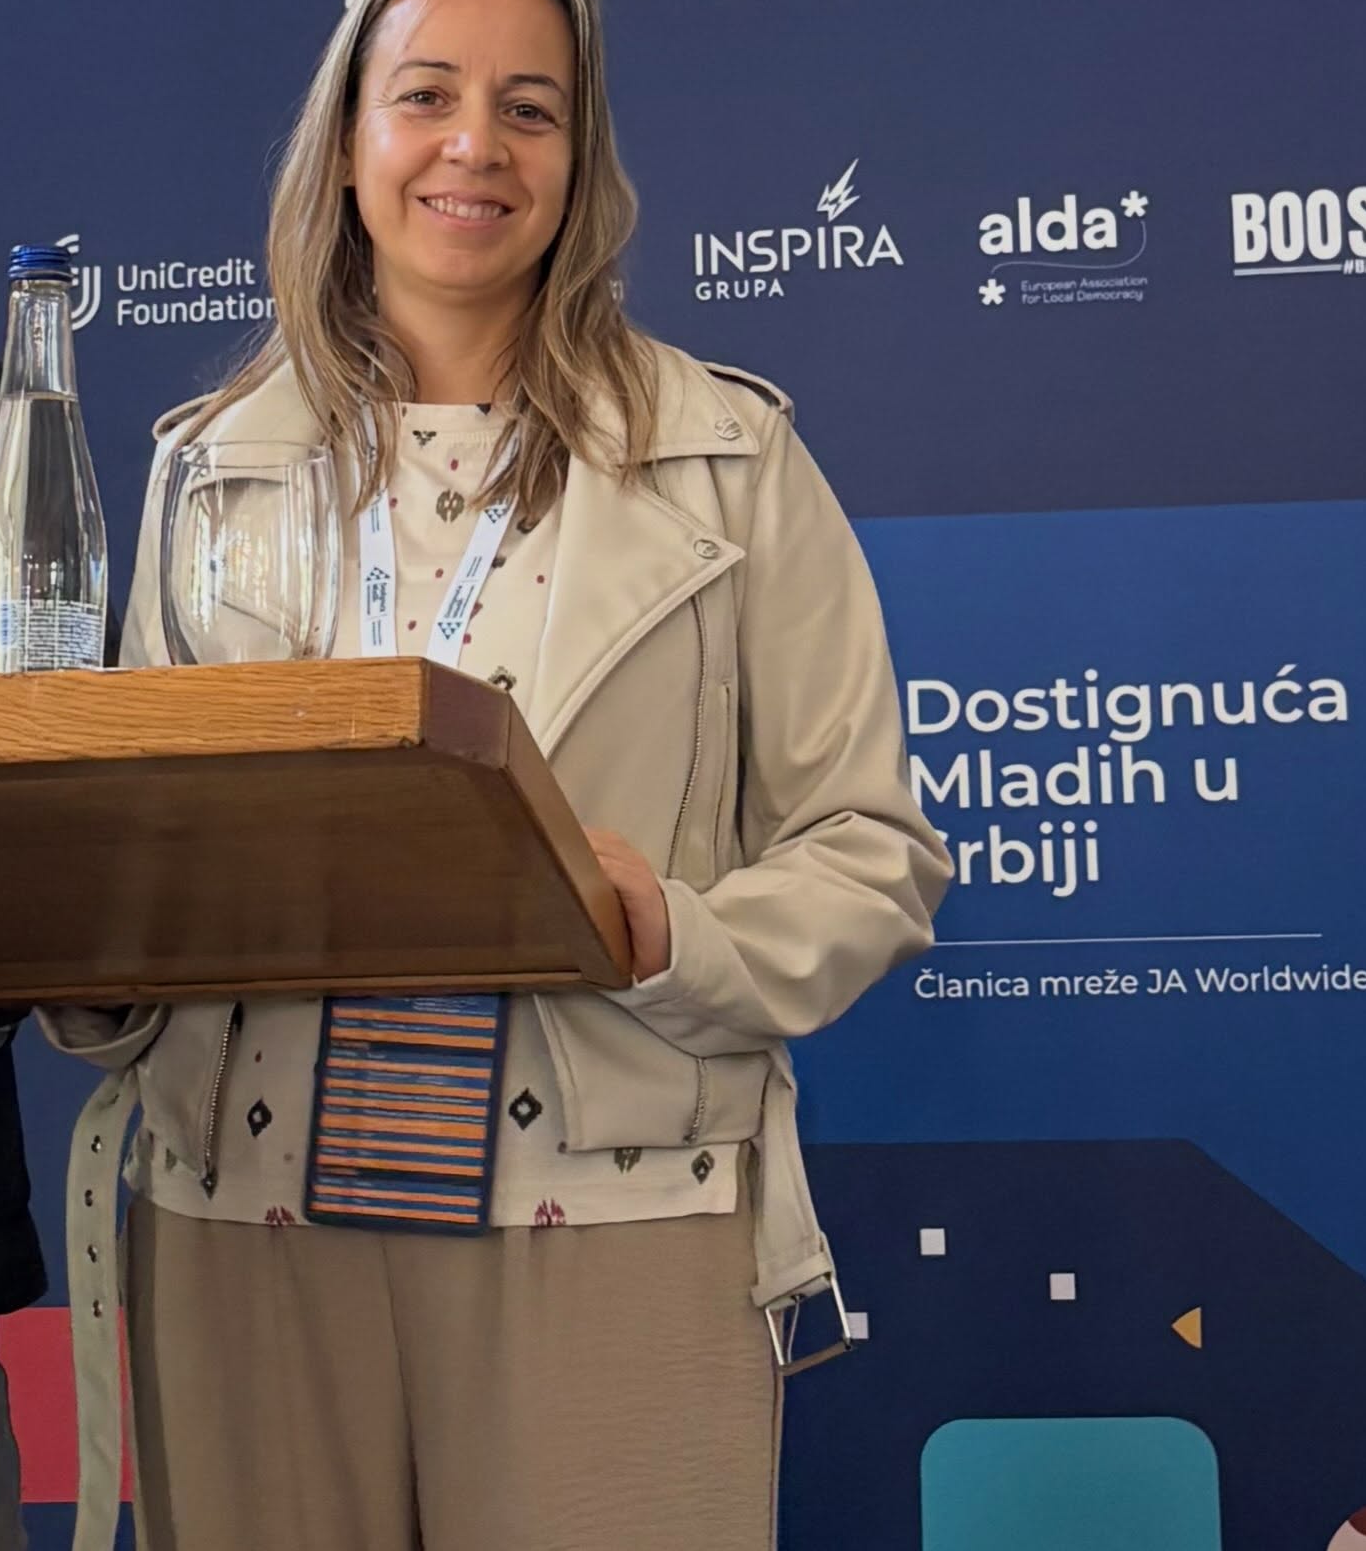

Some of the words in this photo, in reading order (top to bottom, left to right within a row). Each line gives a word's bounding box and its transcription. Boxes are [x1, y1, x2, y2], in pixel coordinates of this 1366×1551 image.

[117, 257, 256, 292] UniCredit
[694, 224, 904, 276] INSPIRA
[695, 278, 784, 301] GRUPA
[906, 663, 1348, 743] Dostignuća
[910, 743, 1166, 809] Mladih
[1194, 757, 1238, 802] u
[935, 819, 1099, 897] rbiji
[914, 968, 1030, 999] Članica
[1040, 969, 1139, 996] mreže
[1146, 968, 1188, 994] JA
